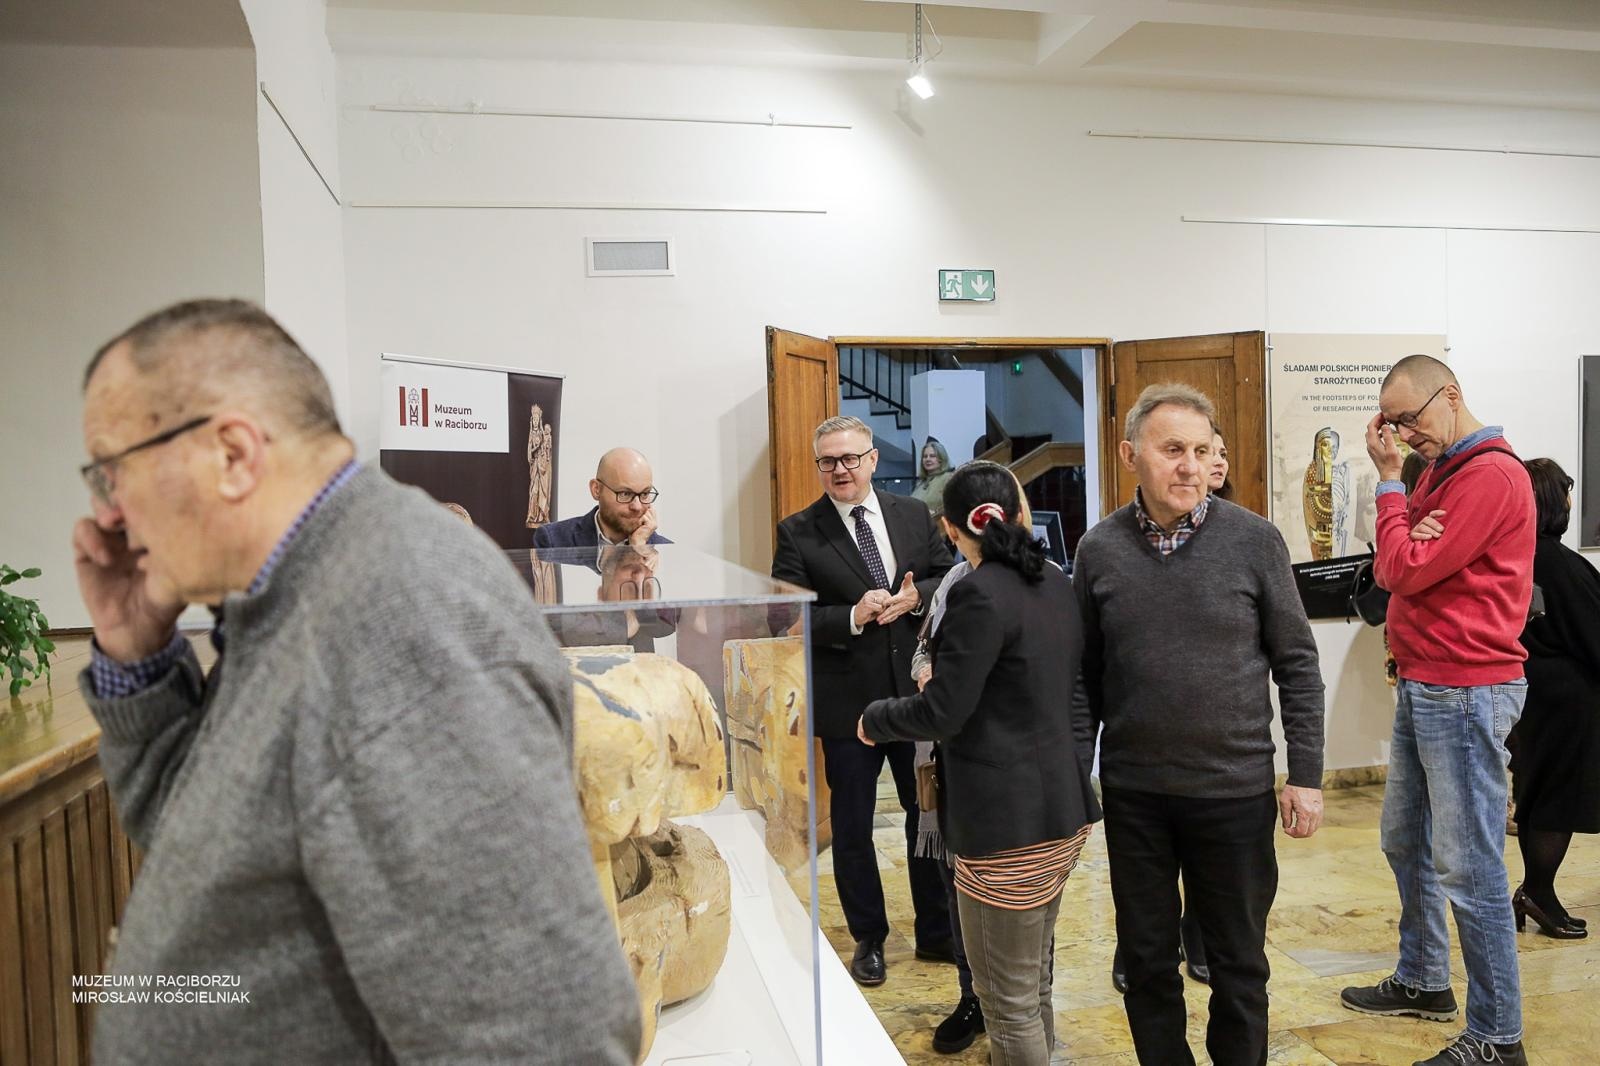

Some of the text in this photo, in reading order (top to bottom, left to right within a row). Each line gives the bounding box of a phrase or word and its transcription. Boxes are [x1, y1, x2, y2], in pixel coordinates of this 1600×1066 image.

[1283, 363, 1319, 372] ŚLADAMI
[1320, 364, 1360, 372] POLSKICH
[1314, 376, 1376, 385] STAROŻYTNEGO
[434, 404, 472, 415] Muzeum
[434, 419, 488, 430] w Raciborzu
